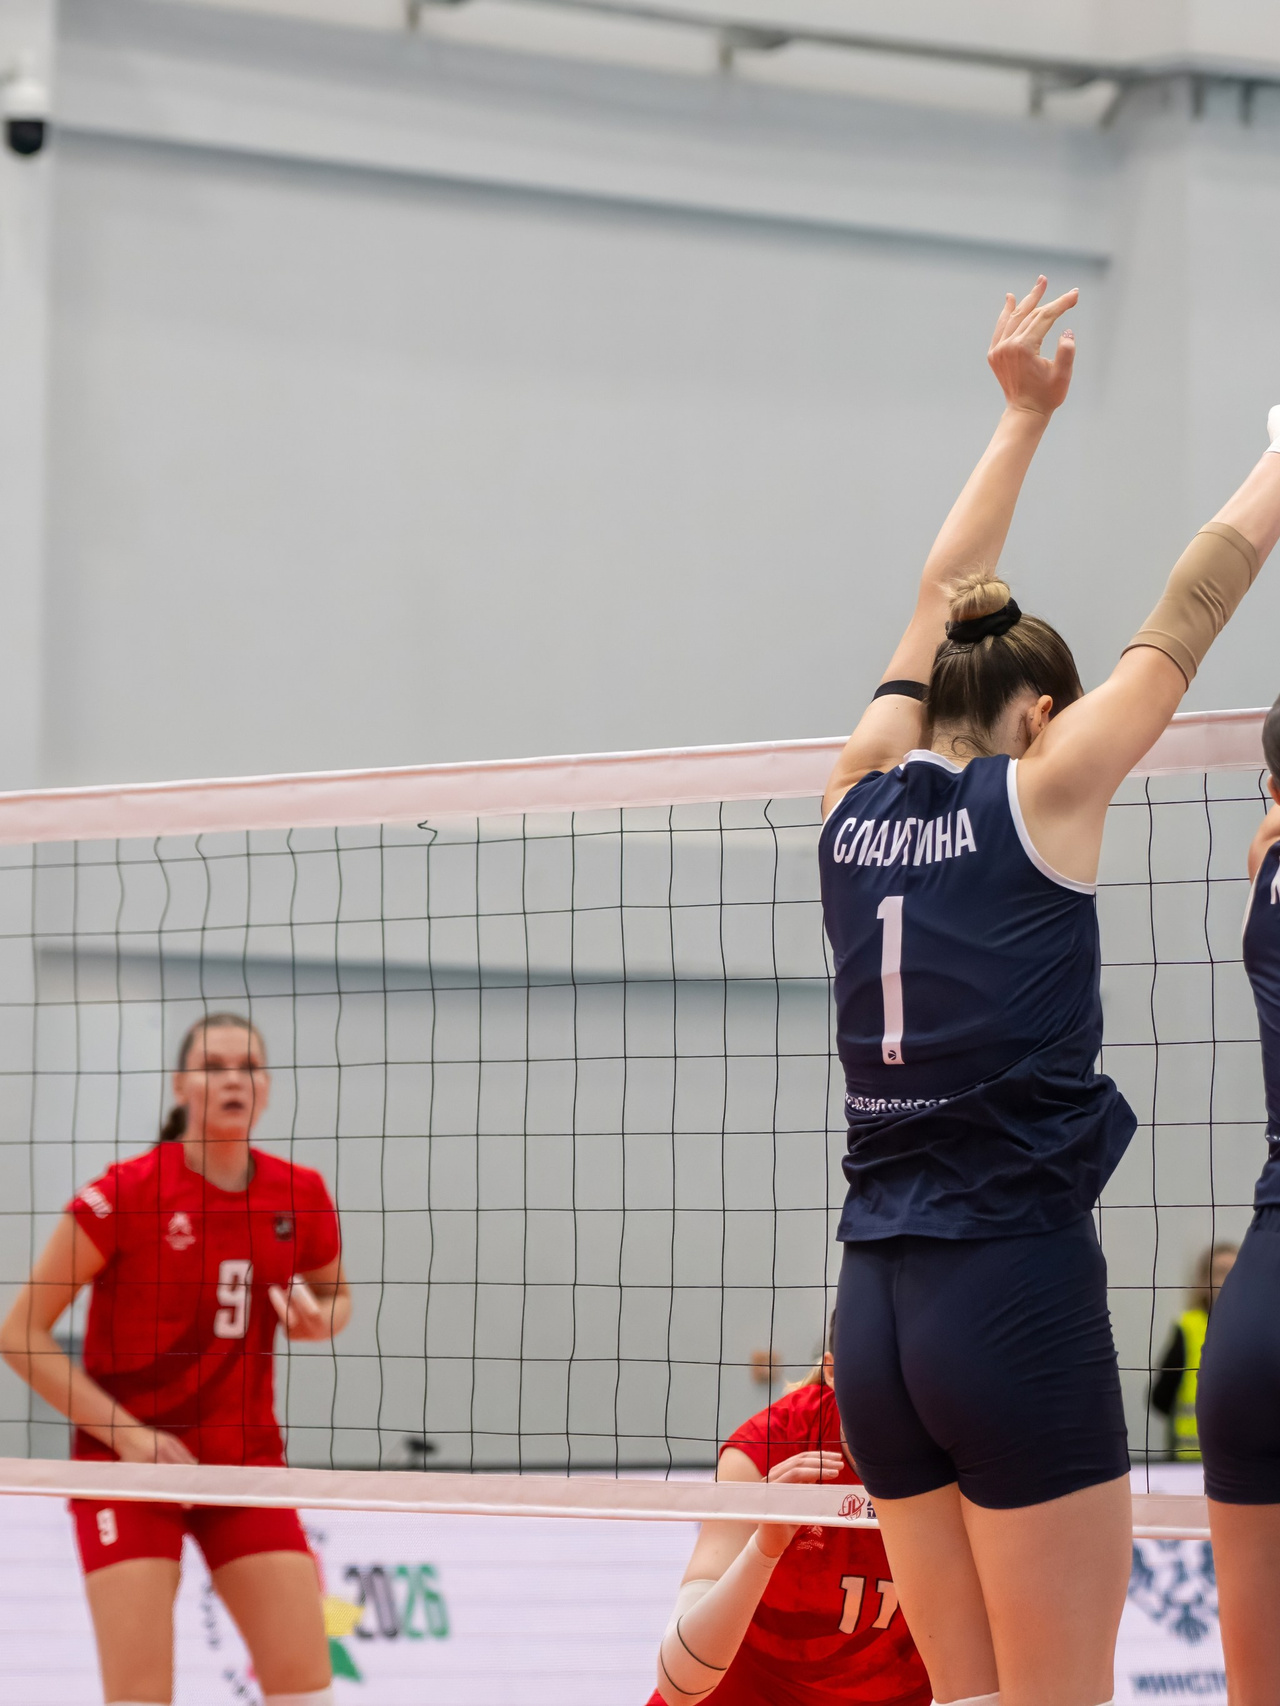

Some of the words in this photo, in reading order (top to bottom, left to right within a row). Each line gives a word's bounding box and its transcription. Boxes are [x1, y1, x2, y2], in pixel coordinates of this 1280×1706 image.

[876, 896, 905, 1065] 1
[213, 1258, 253, 1339] 9
[96, 1507, 119, 1546] 9
[344, 1563, 450, 1640] 2026
[838, 1574, 898, 1634] 11
